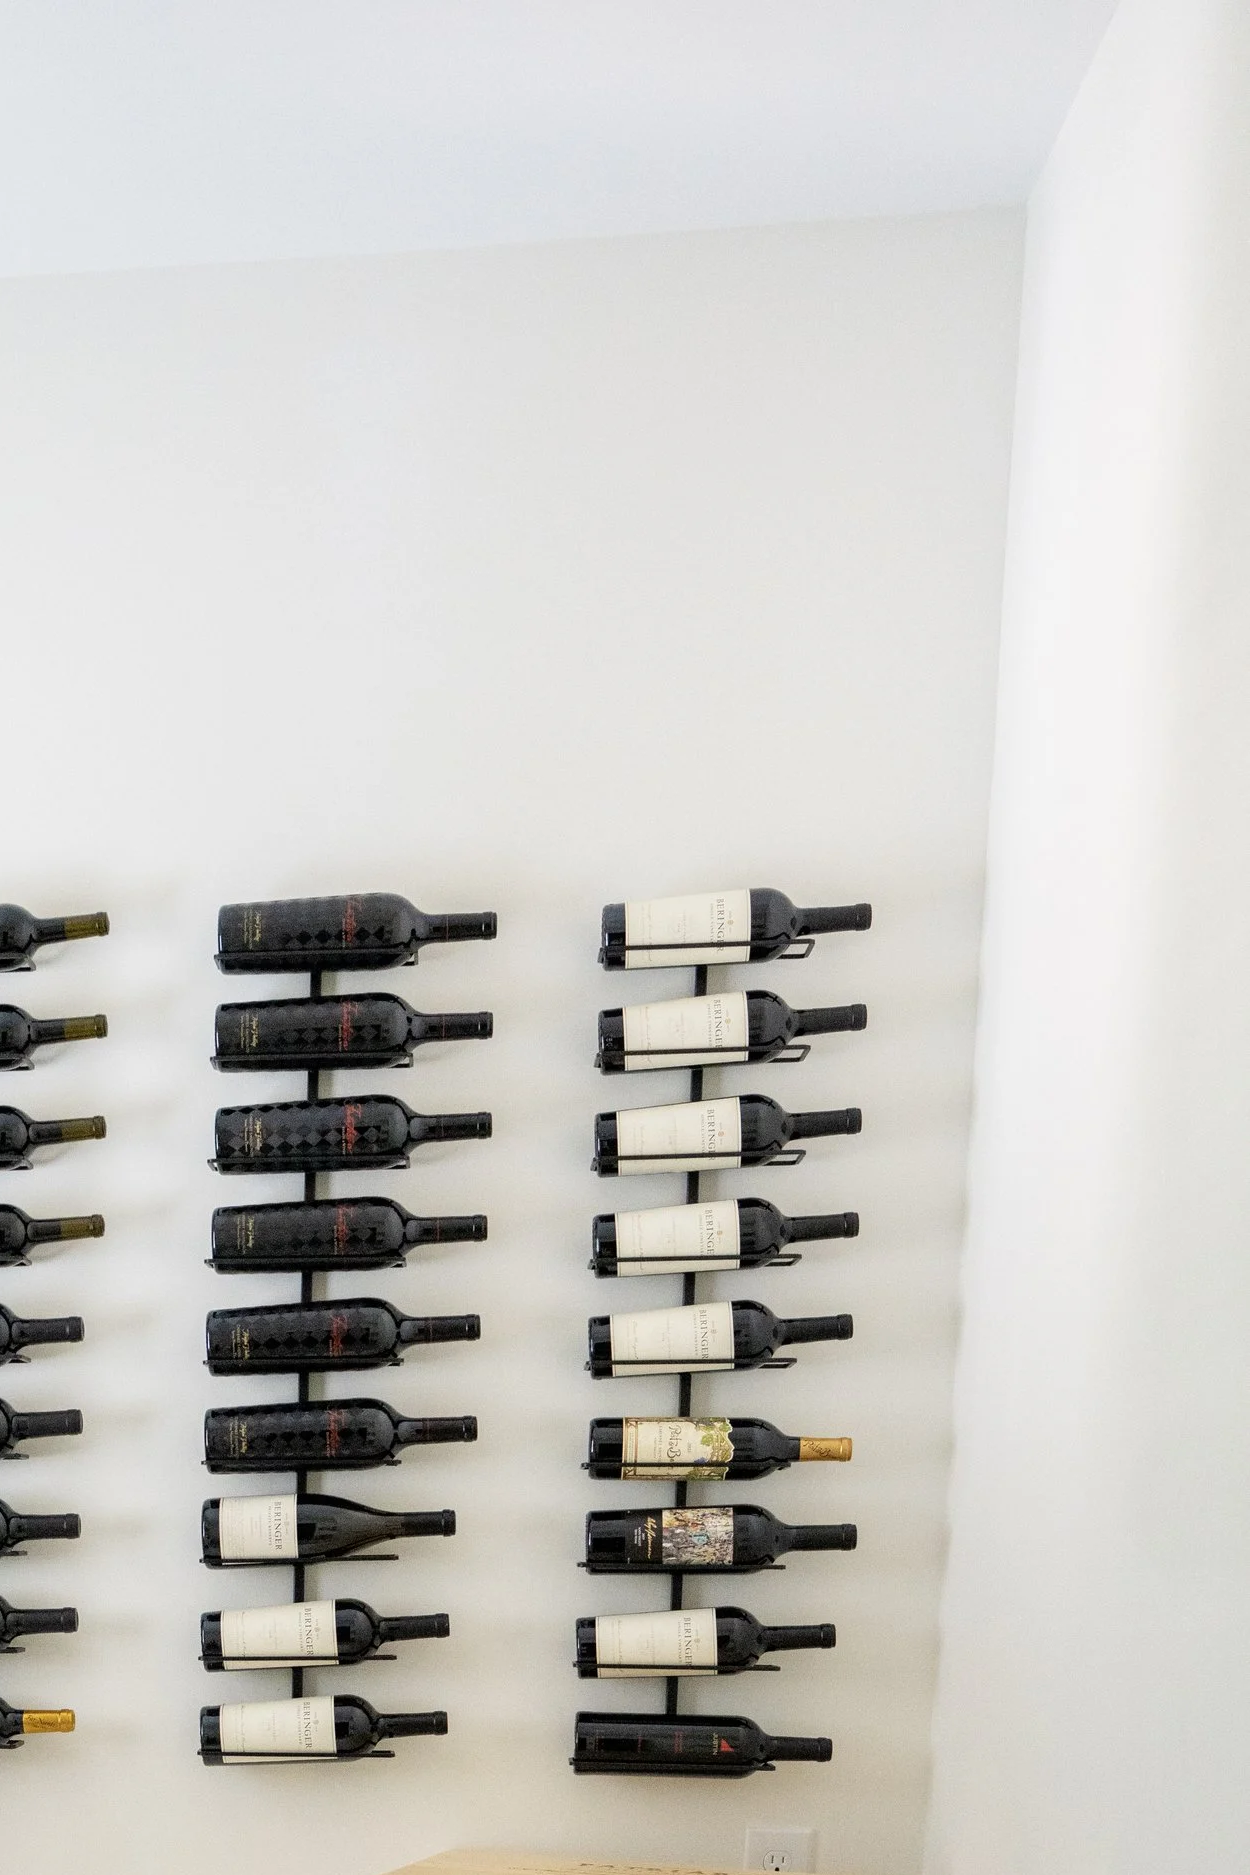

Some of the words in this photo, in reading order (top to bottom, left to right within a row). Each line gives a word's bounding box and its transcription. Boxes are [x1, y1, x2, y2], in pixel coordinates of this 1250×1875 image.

[705, 1210, 715, 1254] BERINGE
[699, 1310, 709, 1360] BERINGER
[274, 1501, 283, 1550] BERINGER
[305, 1607, 314, 1656] BERINGER
[303, 1701, 312, 1749] BERINGER
